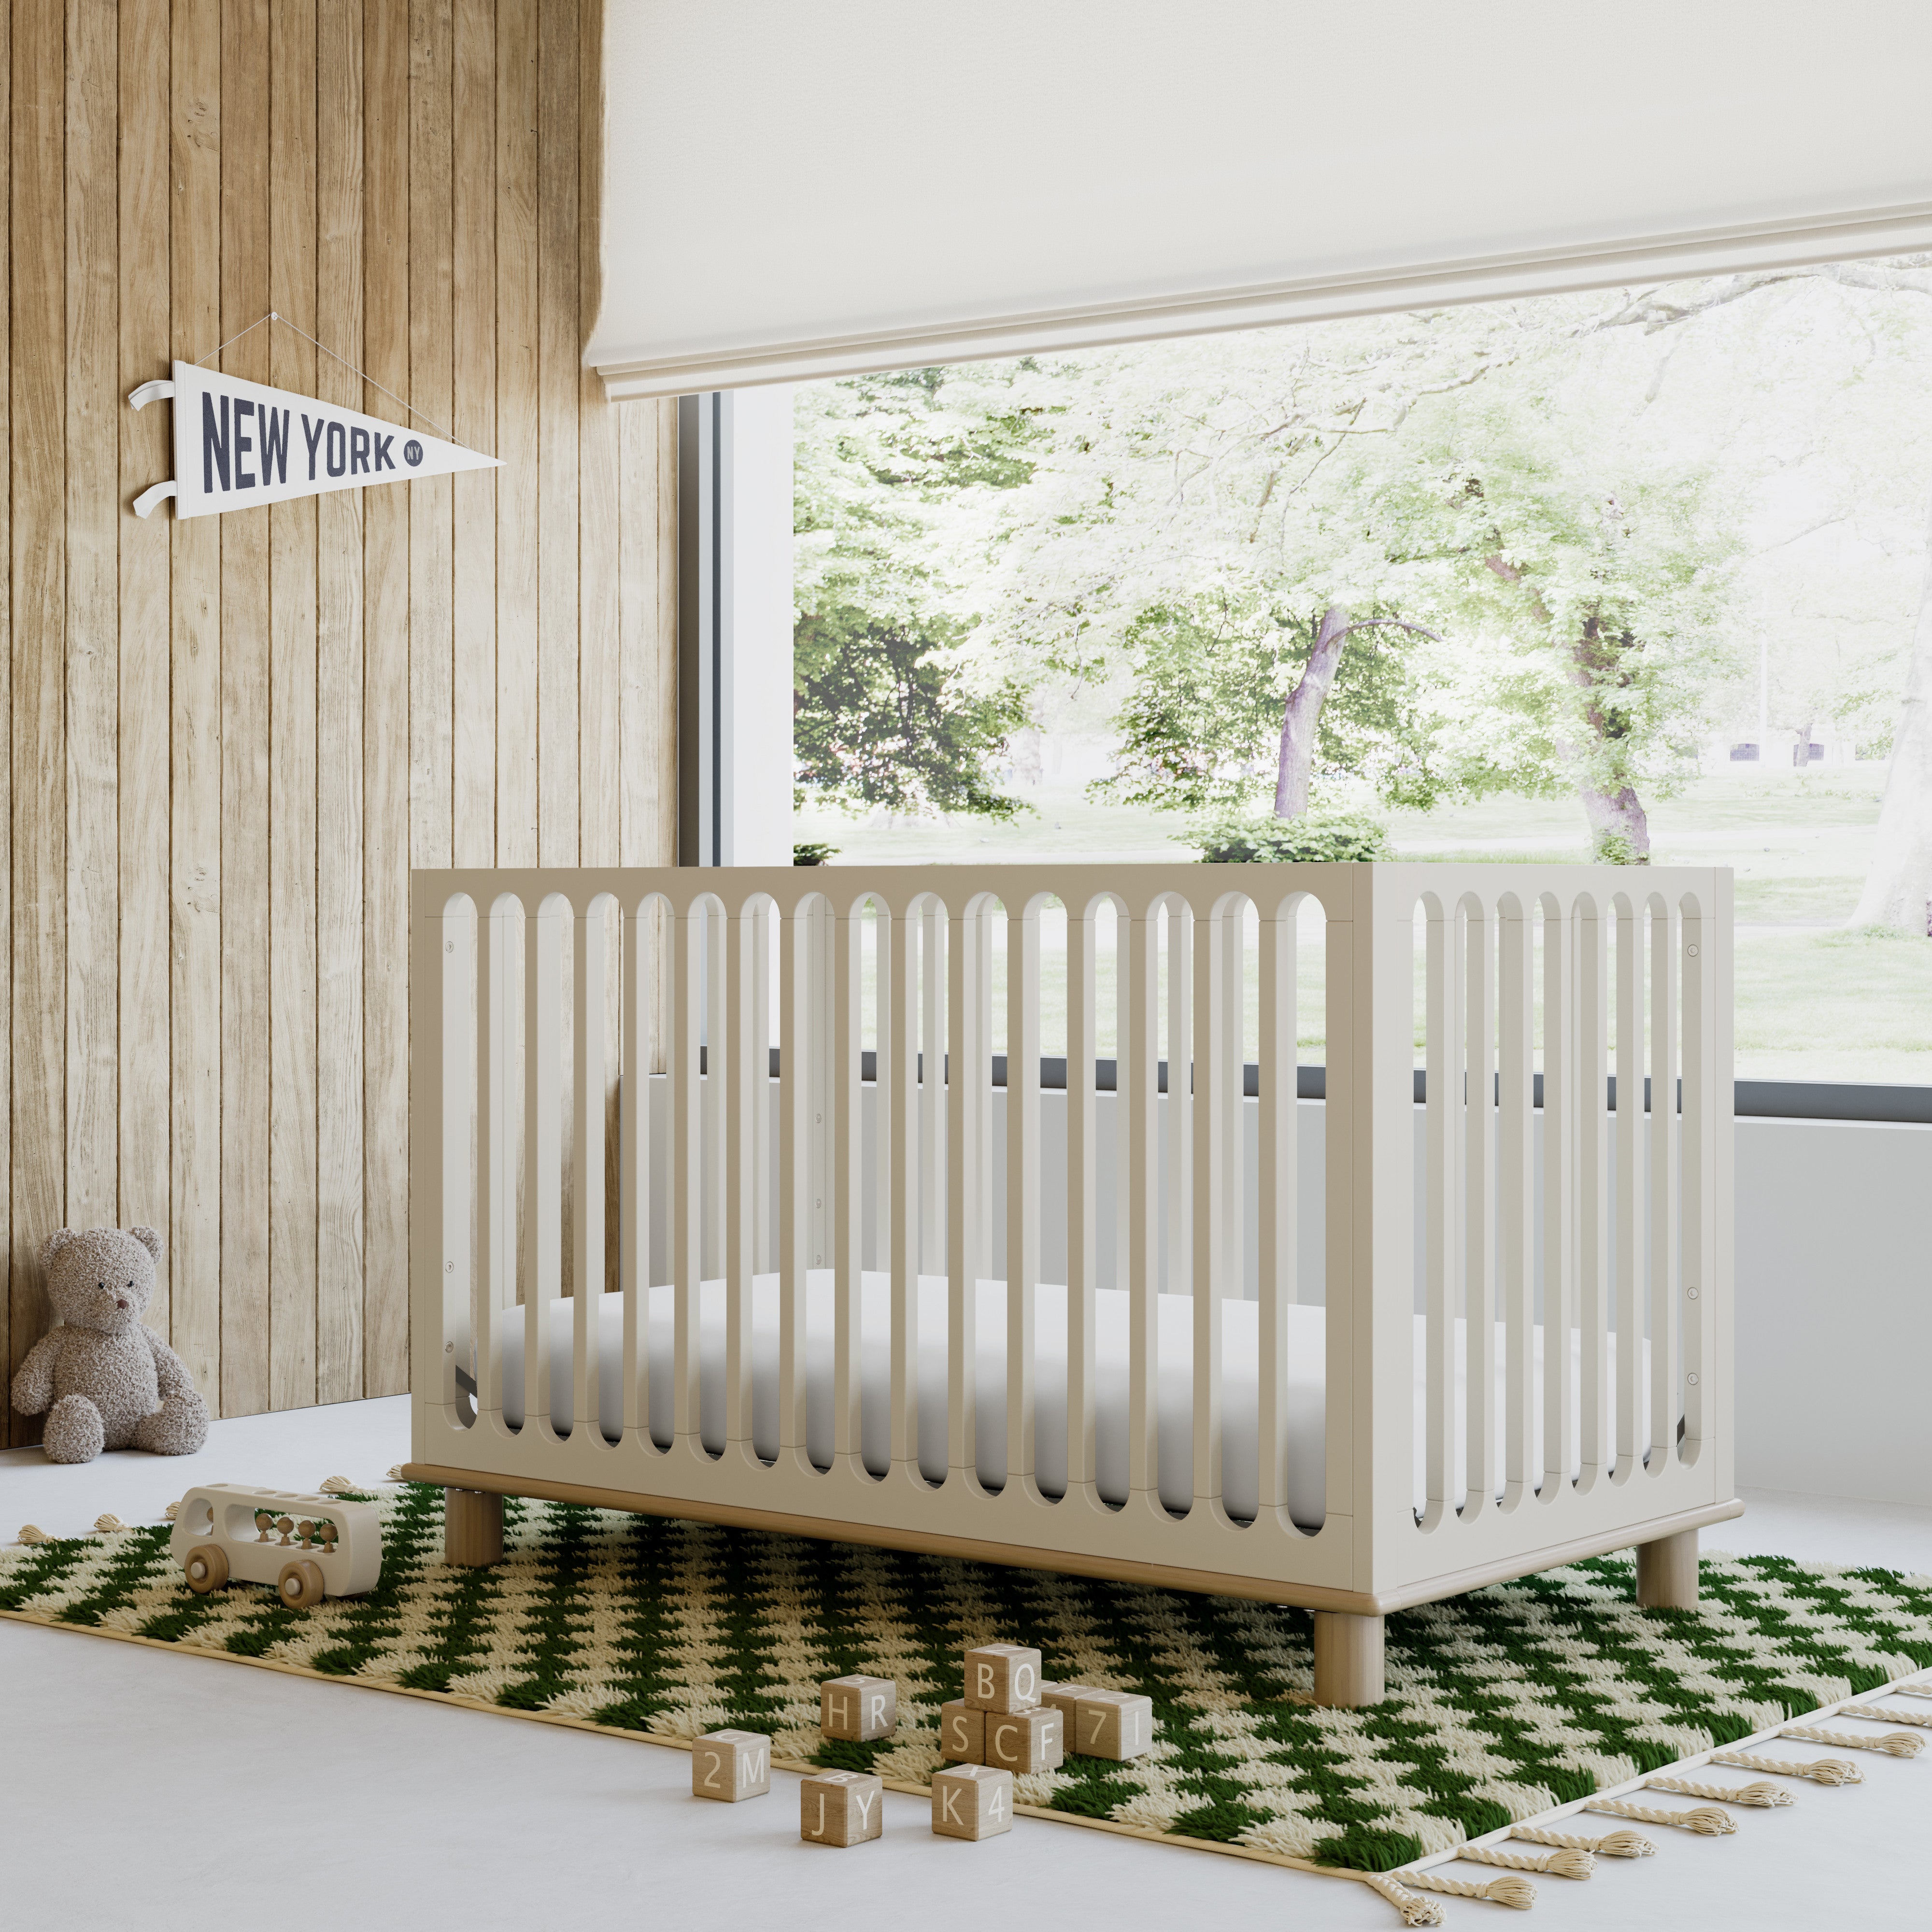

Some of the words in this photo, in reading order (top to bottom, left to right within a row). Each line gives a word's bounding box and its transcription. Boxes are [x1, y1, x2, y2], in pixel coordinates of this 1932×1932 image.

[202, 391, 290, 493] NEW
[300, 413, 396, 480] YORK
[407, 446, 420, 460] NY
[978, 1662, 995, 1699] B
[1014, 1663, 1037, 1703] Q
[1097, 1693, 1130, 1702] 2
[828, 1693, 848, 1730] H
[871, 1694, 888, 1730] R
[1088, 1709, 1107, 1744] 7
[952, 1716, 968, 1752] S
[995, 1724, 1018, 1762] C
[1041, 1722, 1054, 1761] F
[704, 1751, 721, 1789] 2
[743, 1747, 764, 1788] M
[823, 1773, 858, 1783] B
[952, 1766, 996, 1777] X
[811, 1793, 824, 1836] J
[855, 1790, 875, 1830] Y
[943, 1785, 964, 1826] K
[988, 1786, 1005, 1823] 4
